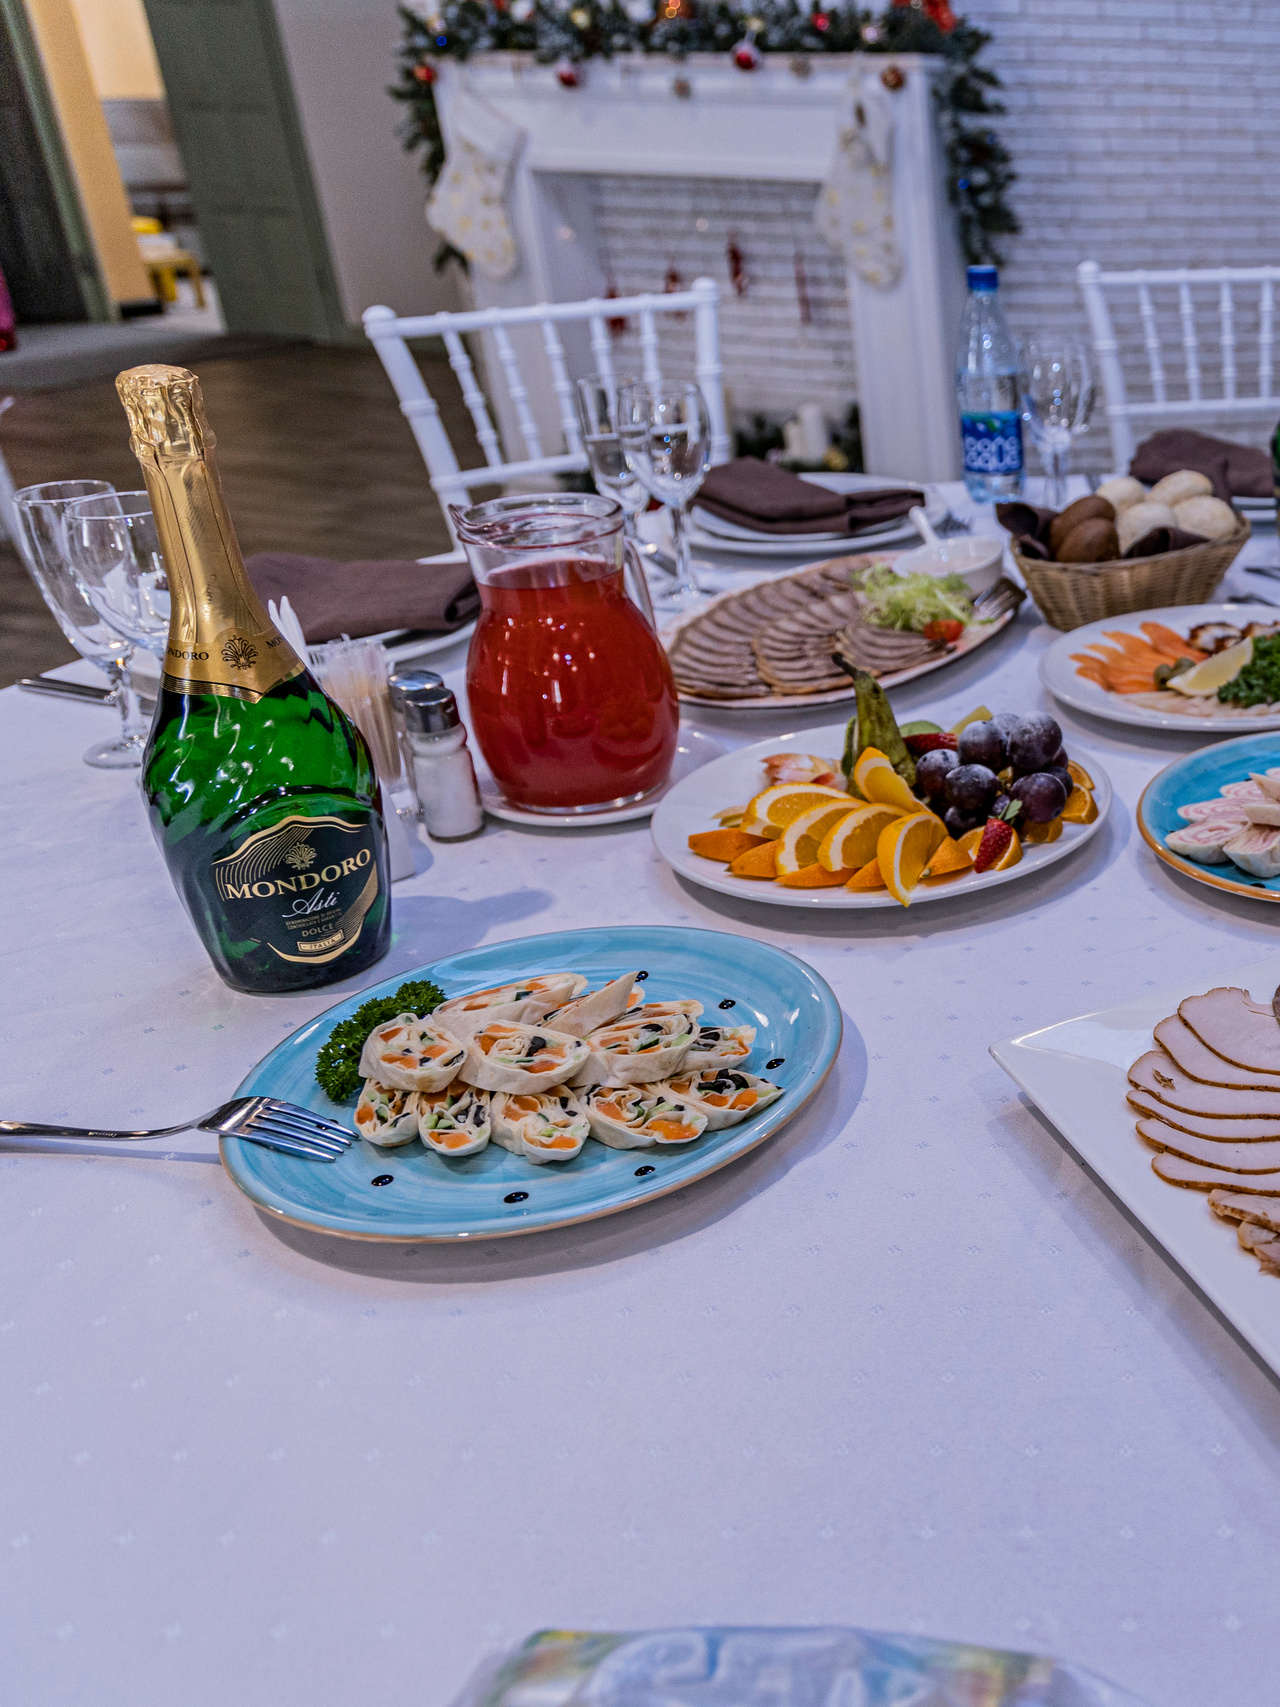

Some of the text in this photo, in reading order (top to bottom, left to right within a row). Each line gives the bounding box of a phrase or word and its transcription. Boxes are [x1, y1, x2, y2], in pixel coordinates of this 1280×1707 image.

[225, 848, 371, 899] MONDORO
[282, 887, 340, 918] Asti
[301, 922, 334, 937] DOLCE
[309, 939, 336, 950] ITALIA
